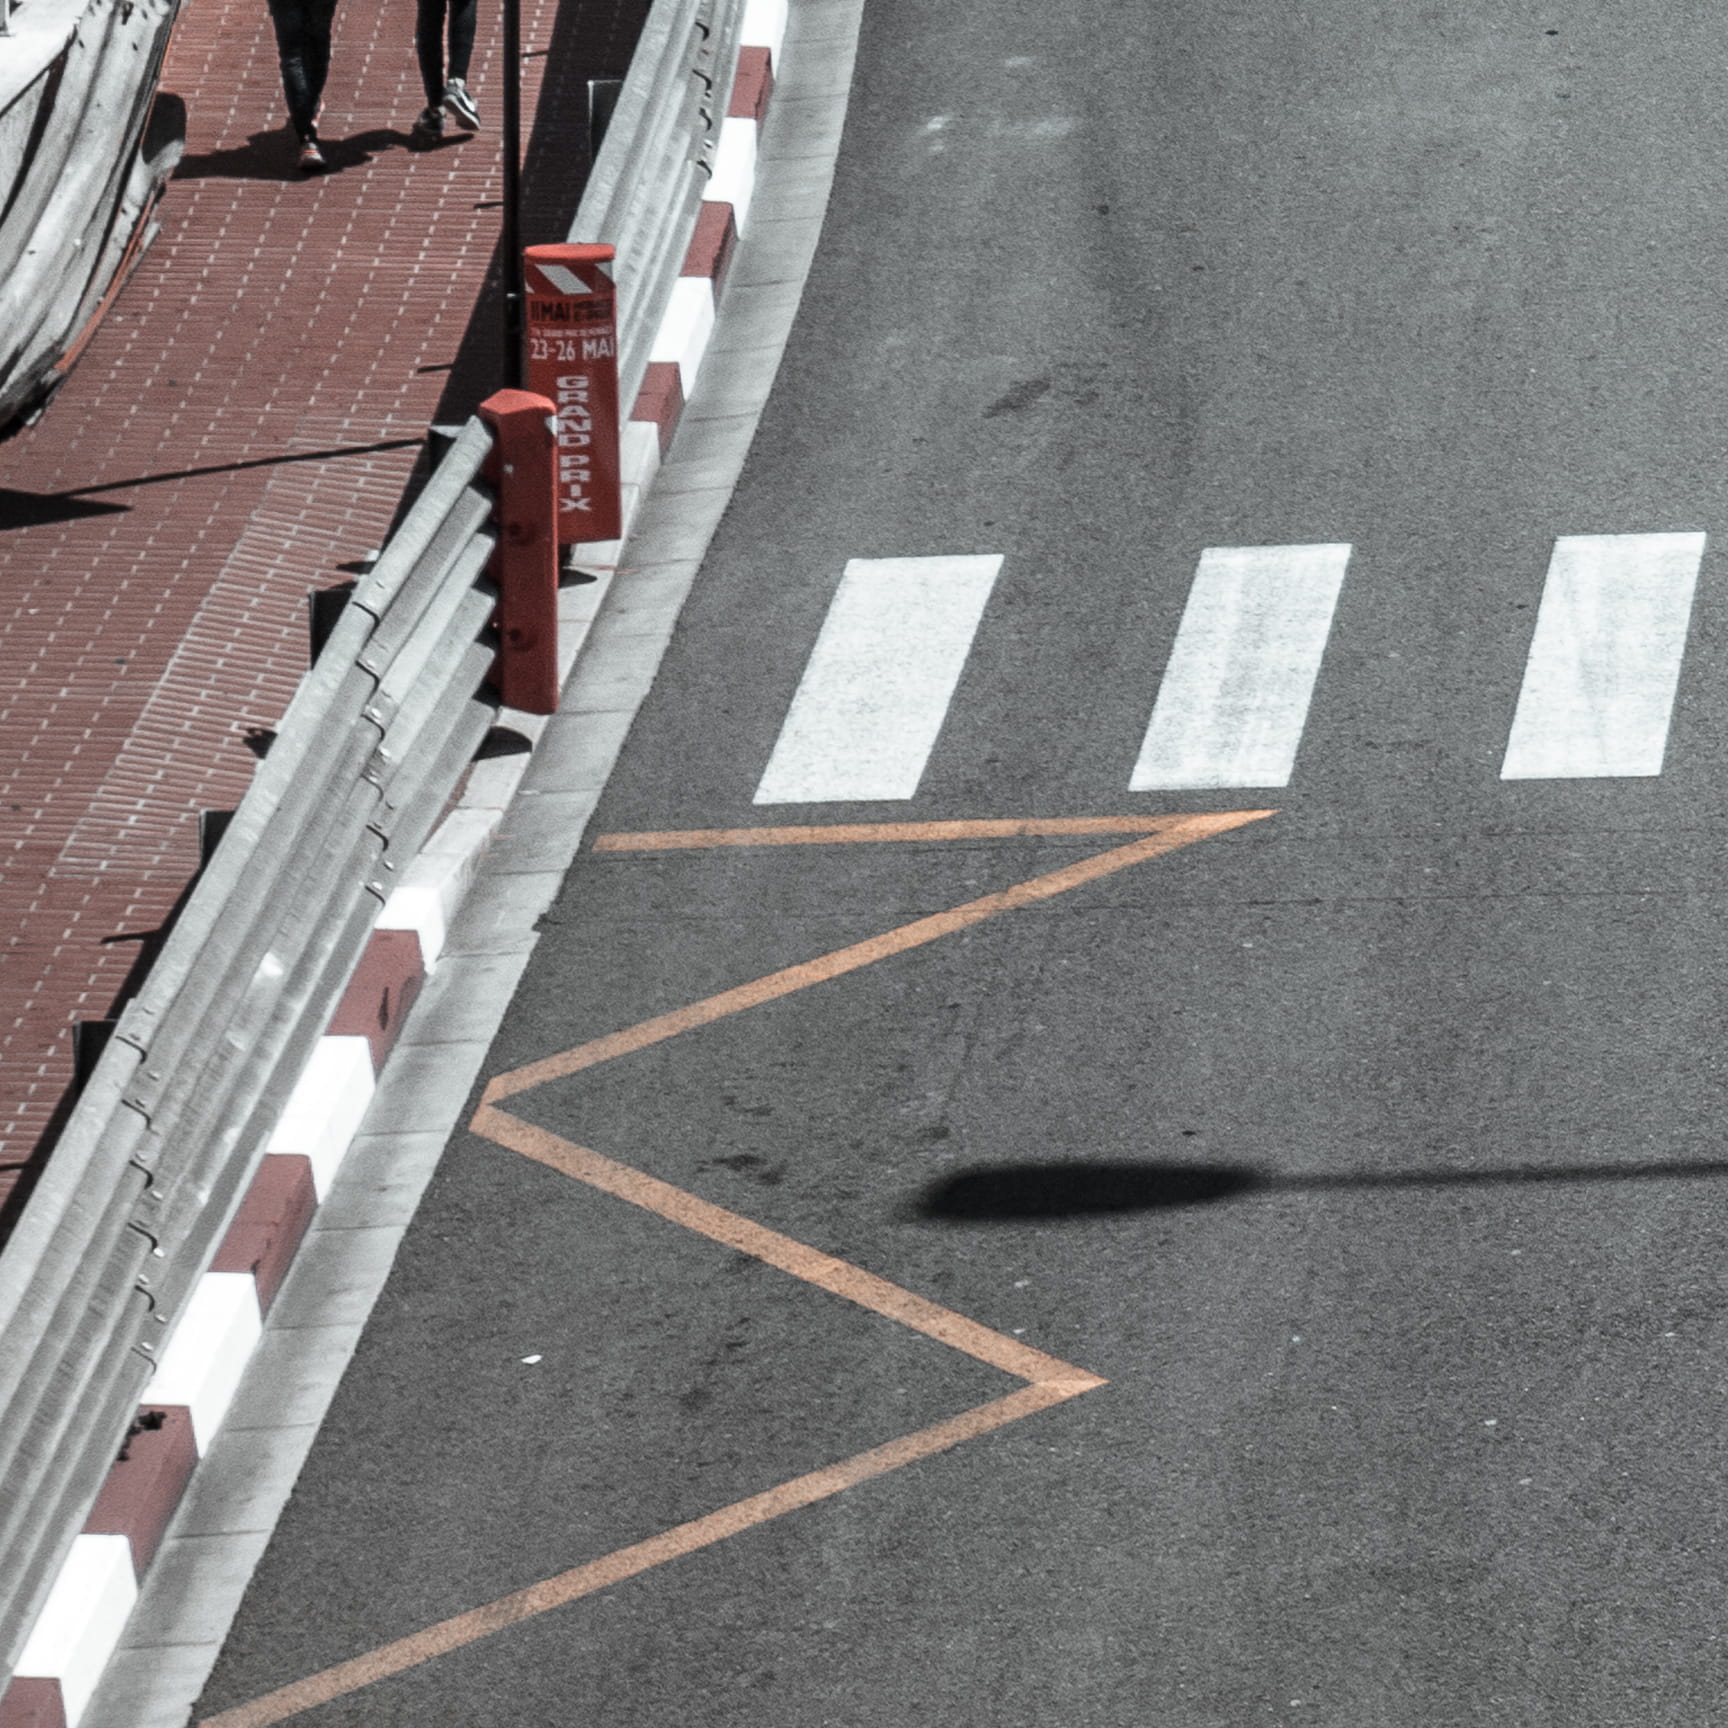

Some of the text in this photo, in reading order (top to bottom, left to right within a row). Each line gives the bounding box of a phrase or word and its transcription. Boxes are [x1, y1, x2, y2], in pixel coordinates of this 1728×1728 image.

[530, 336, 615, 361] 23-26 MAI
[556, 375, 591, 448] GRAND
[559, 454, 592, 512] PRIX
